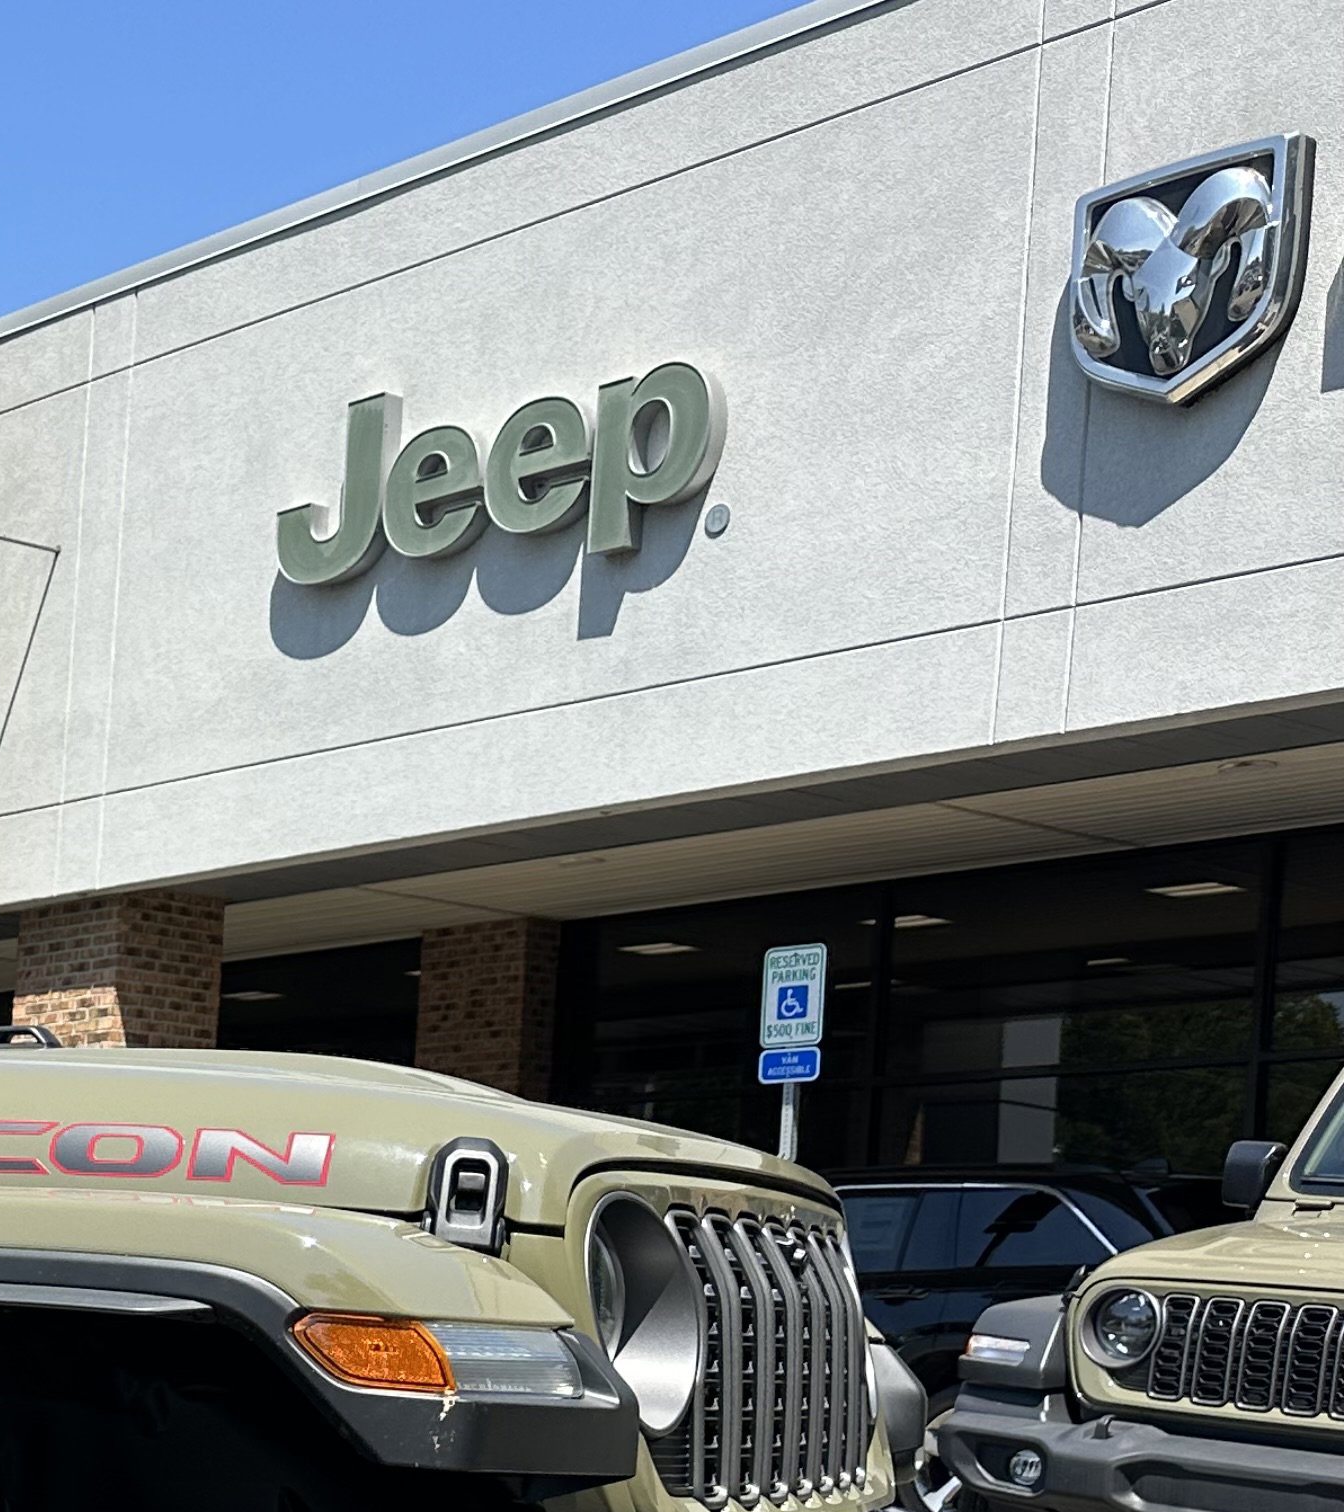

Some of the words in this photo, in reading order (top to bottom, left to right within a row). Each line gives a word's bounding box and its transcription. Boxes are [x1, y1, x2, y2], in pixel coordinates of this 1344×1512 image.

[277, 361, 728, 586] Jeep
[769, 951, 820, 970] RESERVED
[771, 968, 817, 985] PARKING
[767, 1022, 792, 1039] $500
[794, 1020, 817, 1035] FINE
[781, 1054, 799, 1065] VAN
